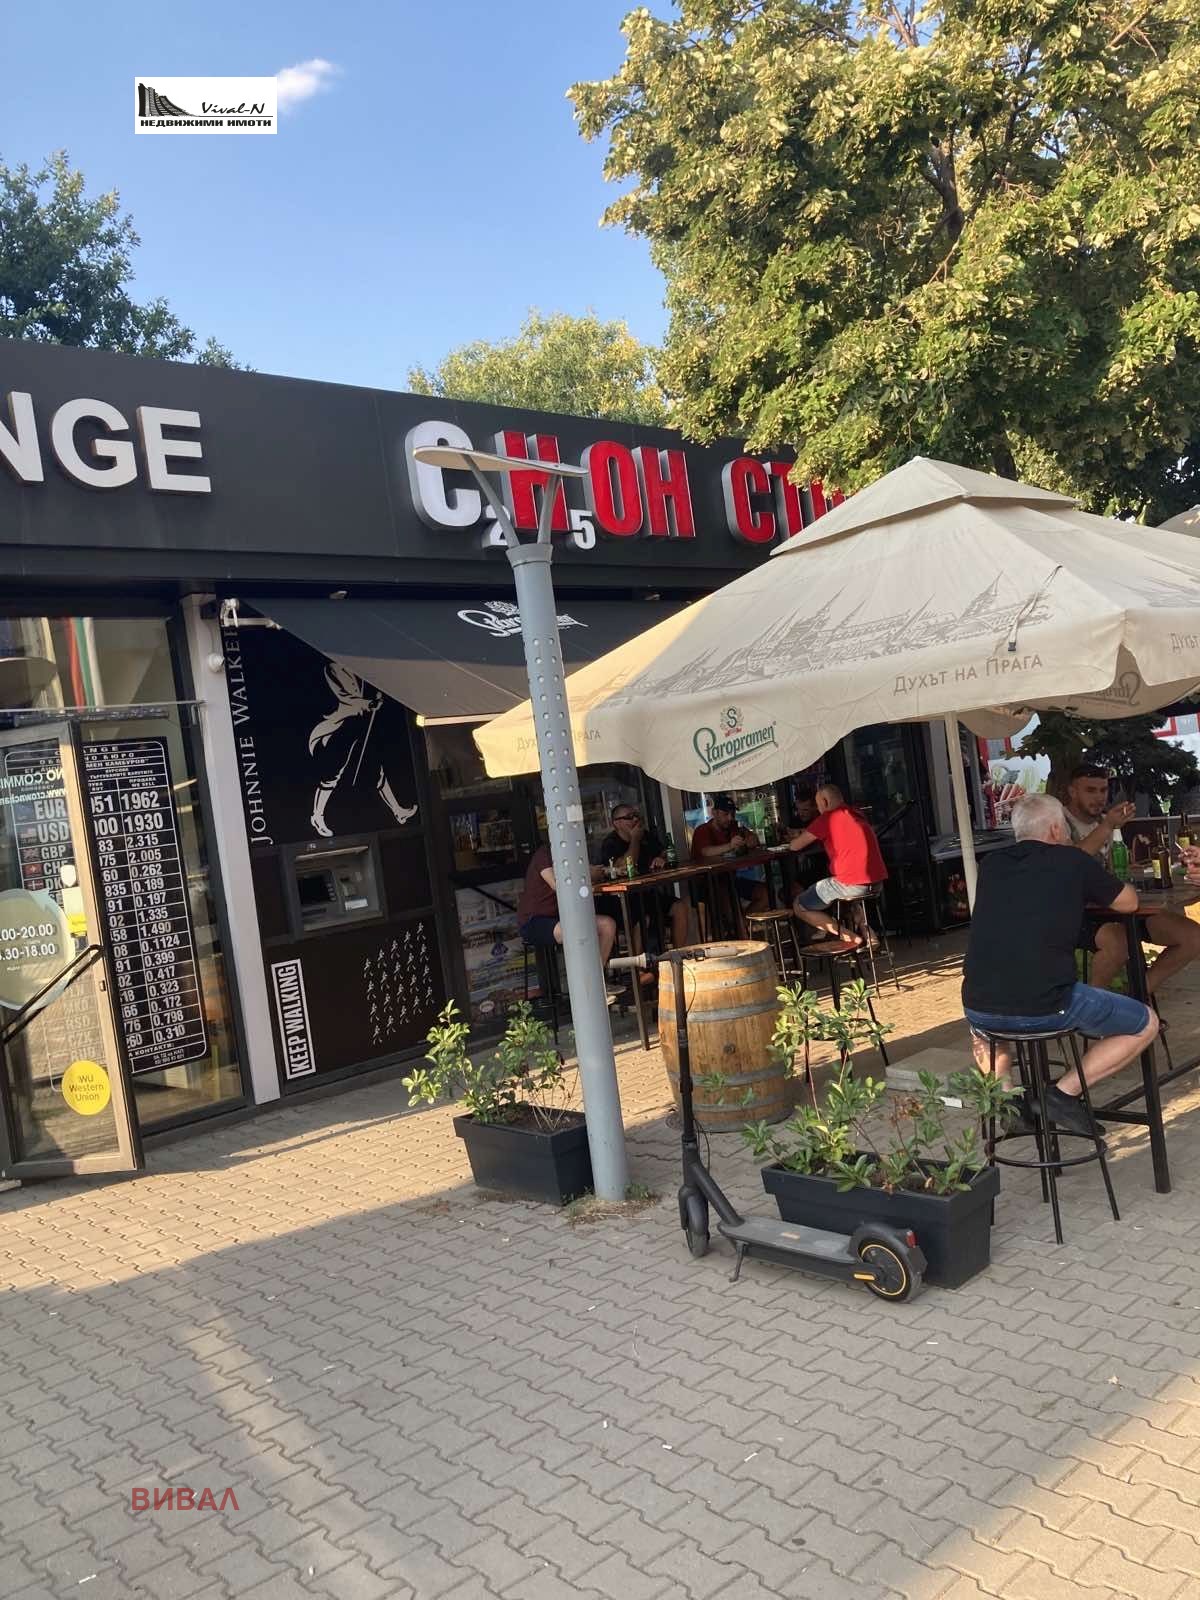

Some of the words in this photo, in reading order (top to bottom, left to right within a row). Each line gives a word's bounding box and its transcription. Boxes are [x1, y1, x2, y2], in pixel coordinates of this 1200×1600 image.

[693, 727, 775, 776] Staropramen
[240, 736, 273, 845] JOHNNIE
[33, 799, 67, 820] EUR
[37, 821, 69, 843] USD
[41, 845, 66, 860] GBP
[126, 833, 159, 849] 2.315
[129, 848, 161, 864] 2.005
[131, 863, 162, 878] 0.262
[133, 877, 165, 893] 0.189
[135, 891, 166, 908] 0.197
[138, 907, 169, 923] 1.335
[110, 928, 128, 942] 58
[140, 921, 172, 937] 1.490
[0, 943, 55, 961] .30-18.00
[142, 934, 181, 953] 0.1124
[144, 950, 175, 967] 0.399
[146, 965, 175, 982] 0.417
[120, 989, 135, 1003] 18
[149, 980, 180, 997] 0.323
[277, 964, 307, 1033] WALKING
[151, 995, 183, 1013] 0.172
[153, 1010, 184, 1027] 0.798
[155, 1024, 186, 1043] 0.310
[286, 1033, 310, 1075] KEEP
[68, 1083, 104, 1093] Western
[79, 1075, 94, 1083] WU
[75, 1094, 100, 1102] Union
